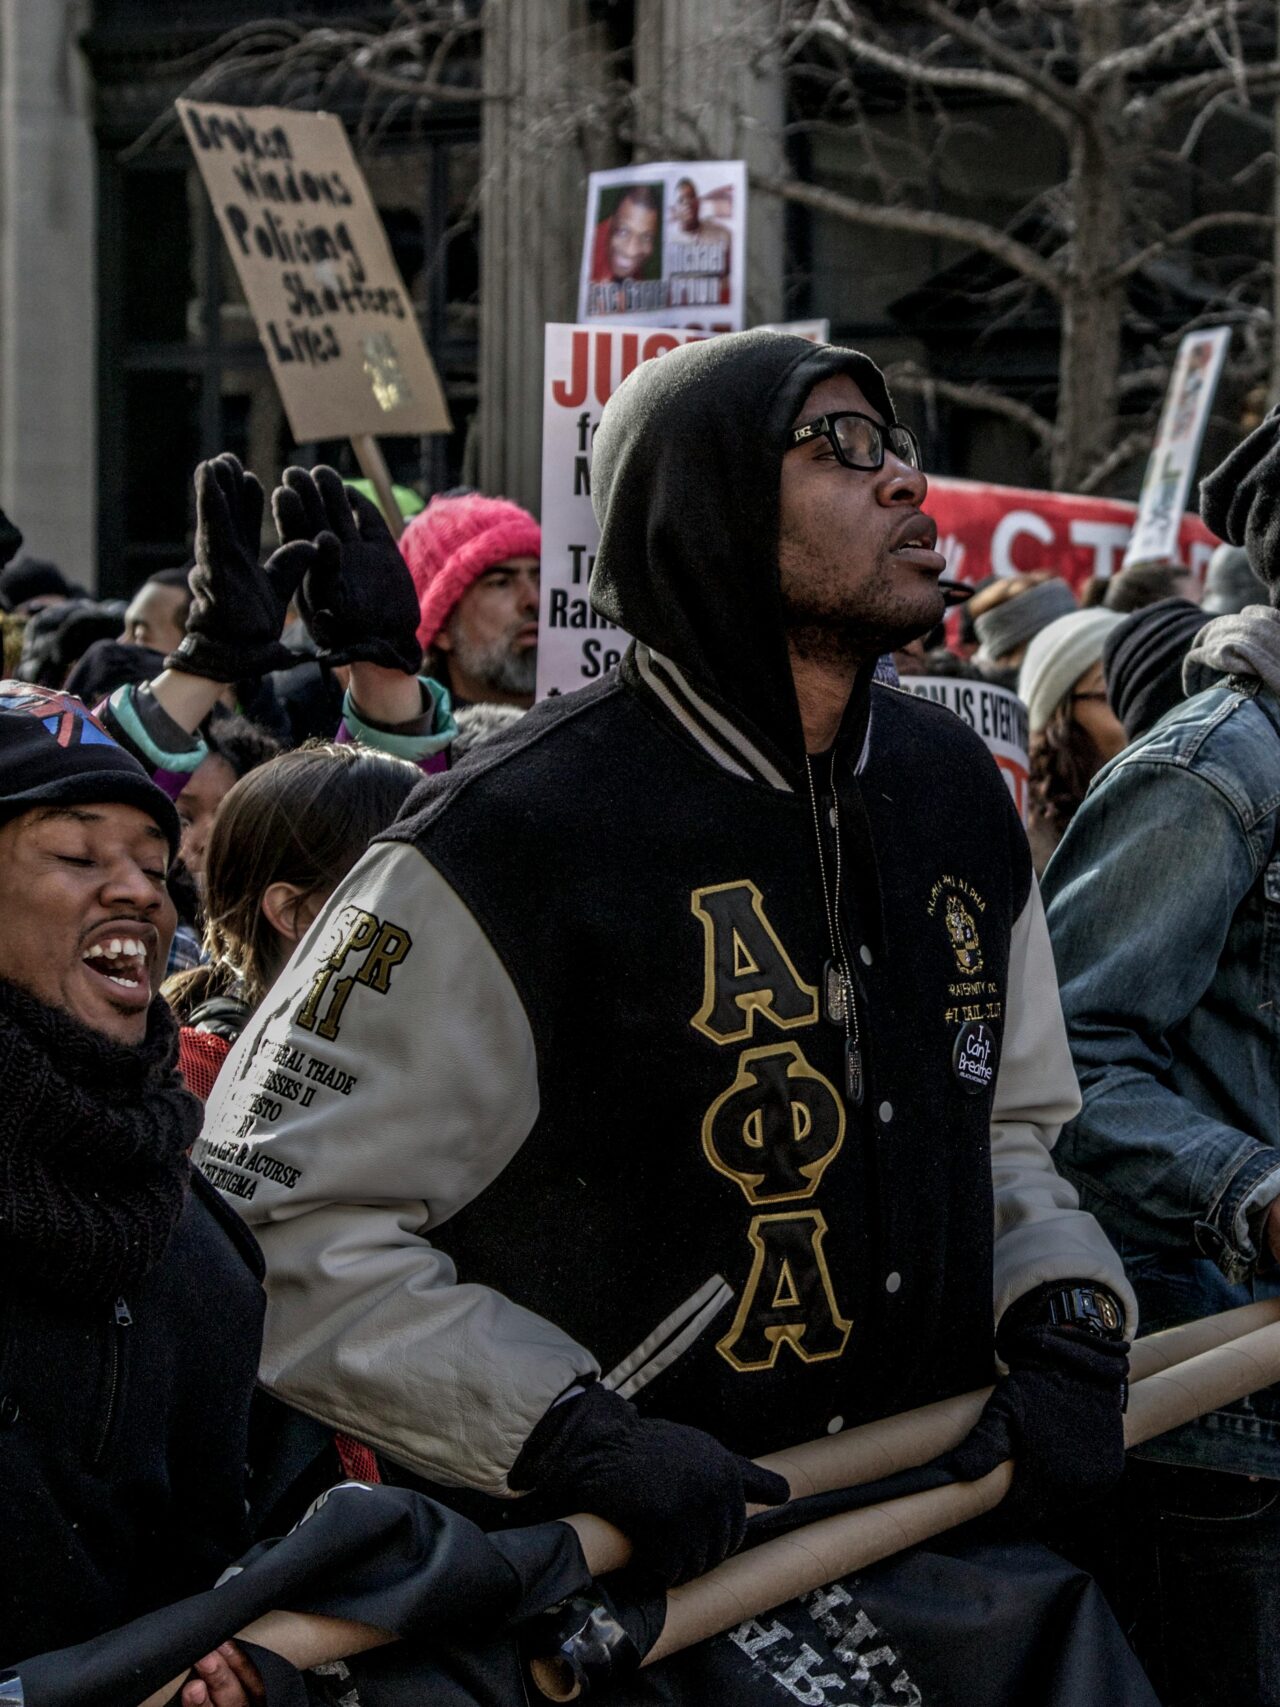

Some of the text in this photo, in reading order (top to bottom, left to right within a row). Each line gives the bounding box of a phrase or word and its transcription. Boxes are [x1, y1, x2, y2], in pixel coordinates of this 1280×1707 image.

[225, 204, 366, 283] Policing
[959, 879, 986, 913] ALPHA
[966, 1034, 992, 1061] Can't
[978, 1024, 985, 1043] I
[305, 1058, 358, 1096] THADE
[958, 1052, 993, 1080] Breathe
